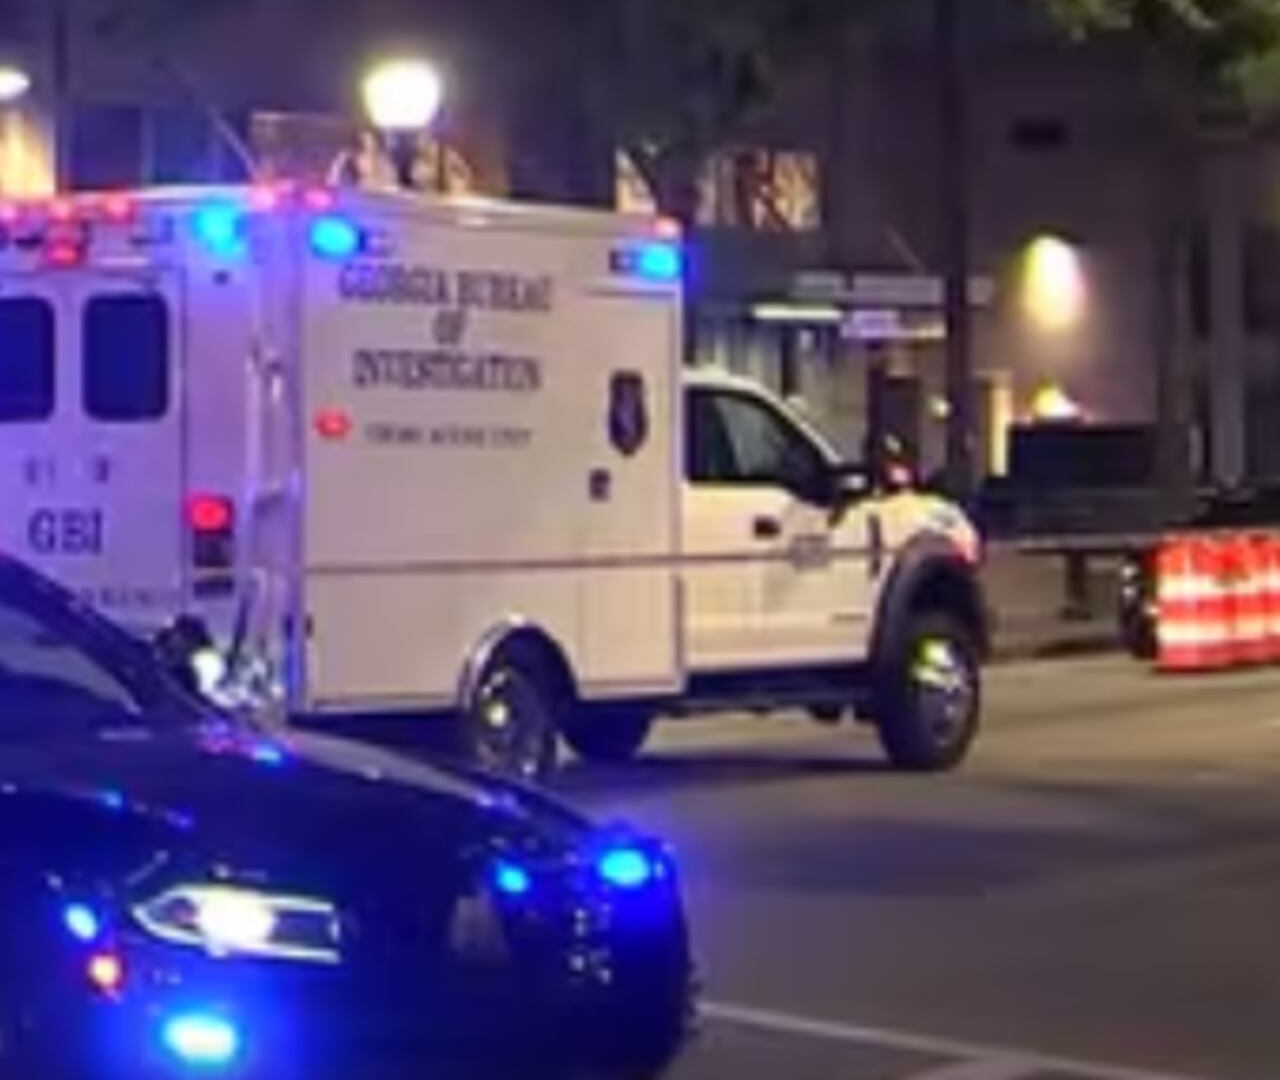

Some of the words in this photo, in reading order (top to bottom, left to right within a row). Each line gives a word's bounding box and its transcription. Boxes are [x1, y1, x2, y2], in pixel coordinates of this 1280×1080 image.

[338, 262, 449, 306] GEORGIA
[352, 348, 542, 392] INVESTIGATION
[26, 507, 104, 556] GBI
